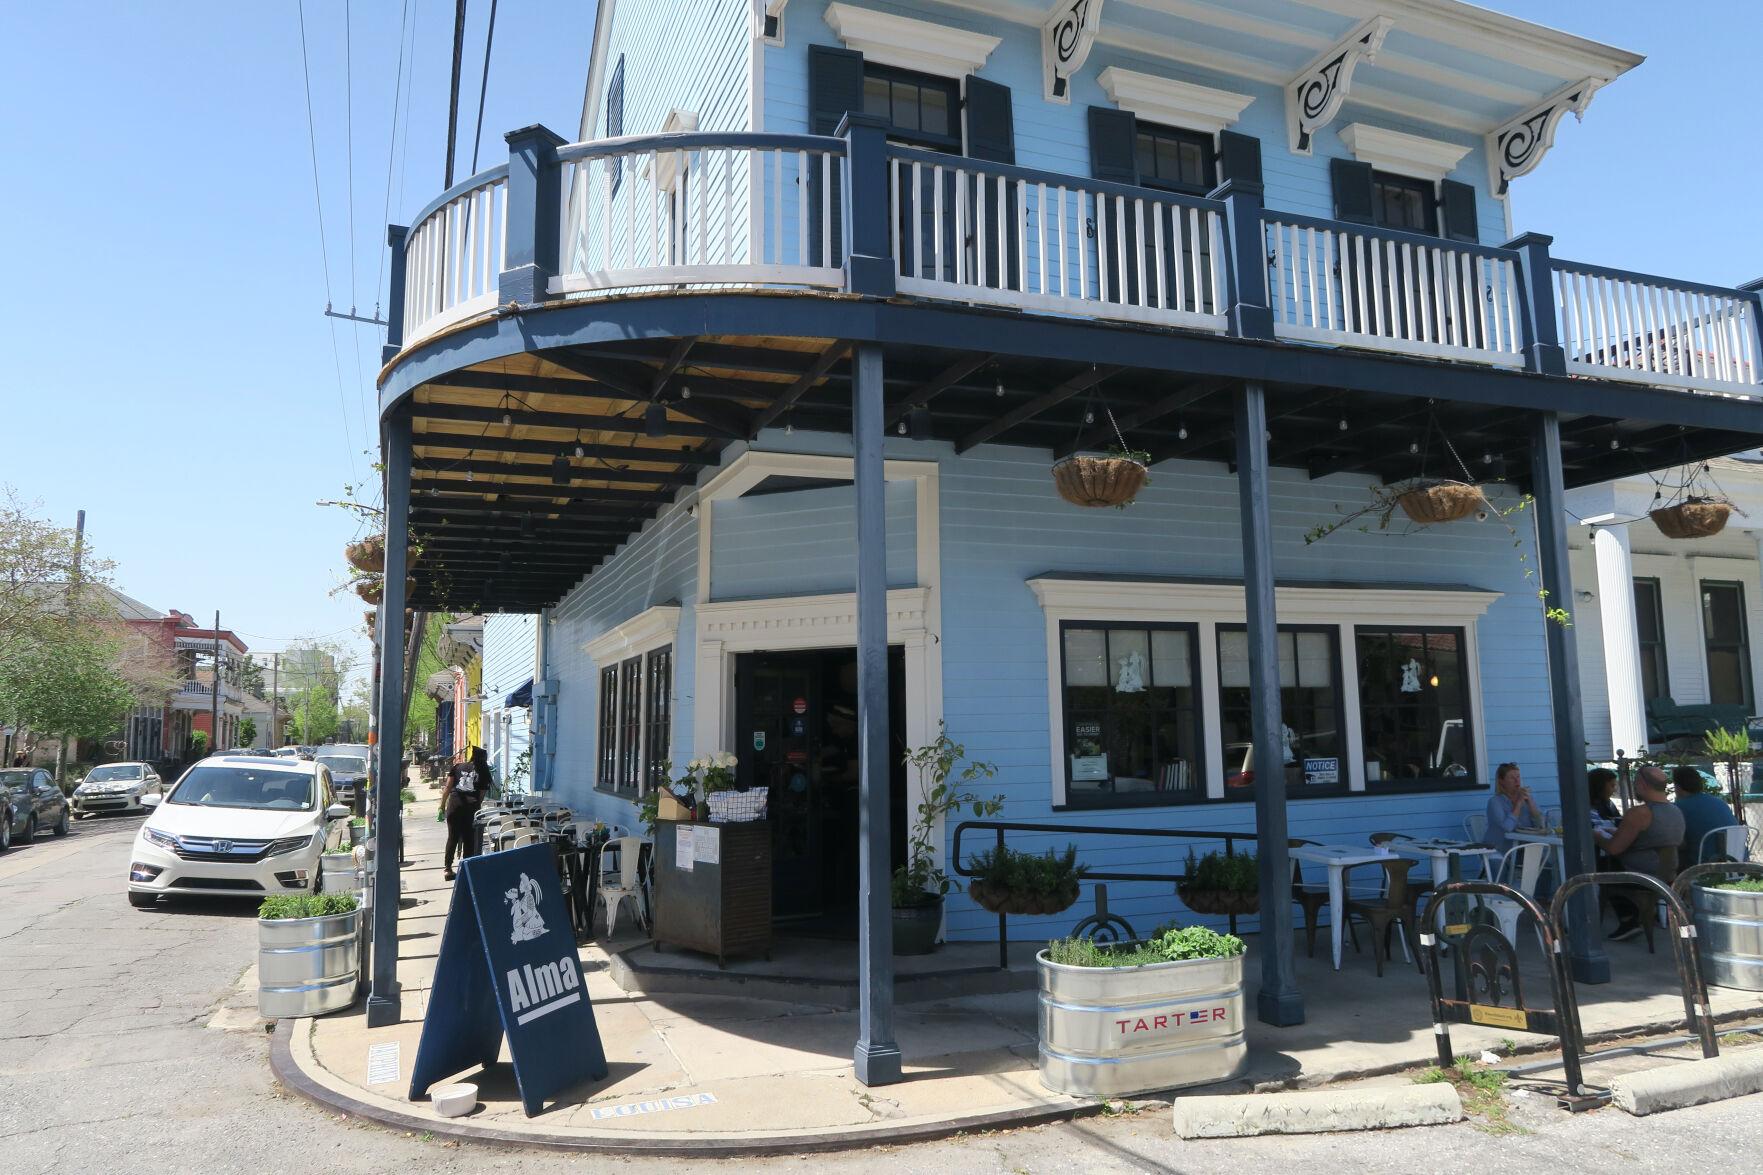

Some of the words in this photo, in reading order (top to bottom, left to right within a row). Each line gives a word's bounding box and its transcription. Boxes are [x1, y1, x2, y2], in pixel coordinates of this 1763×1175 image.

[1306, 761, 1336, 771] NOTICE
[506, 956, 580, 1013] Alma
[1115, 1007, 1226, 1034] TARTER
